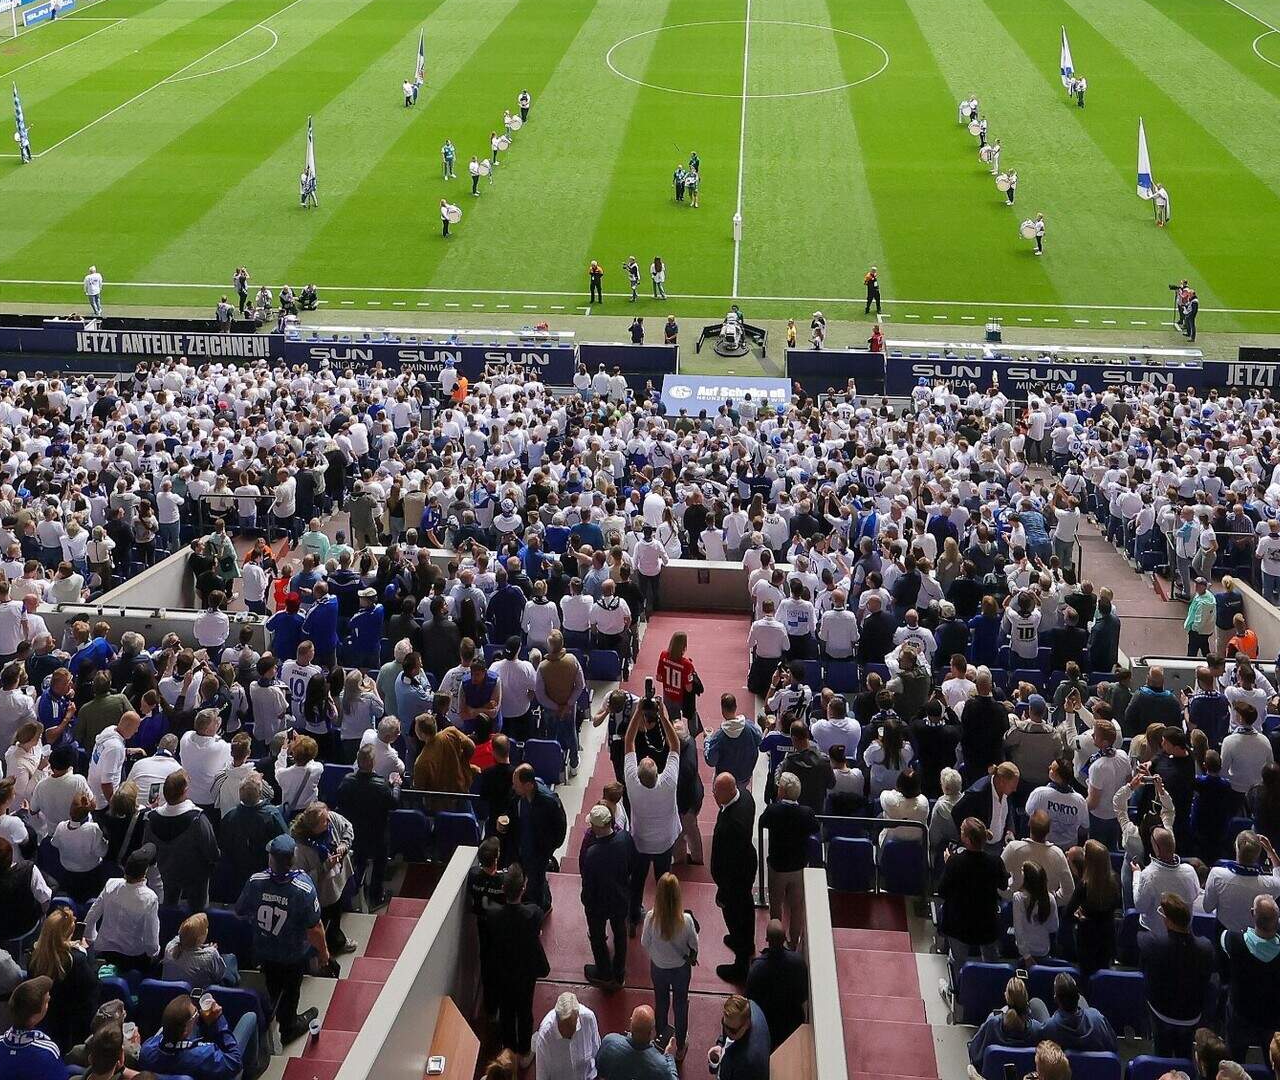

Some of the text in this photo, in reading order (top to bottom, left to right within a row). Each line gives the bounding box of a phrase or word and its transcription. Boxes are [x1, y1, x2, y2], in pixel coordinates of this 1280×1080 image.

[26, 7, 49, 21] SUN
[77, 331, 270, 357] JETZT ANTEILE ZEICHNEN!
[309, 347, 373, 361] SUN
[398, 349, 462, 363] SUN
[484, 352, 551, 365] SUN
[912, 364, 981, 378] SUN
[1007, 367, 1077, 381] SUN
[1102, 370, 1174, 384] SUN
[1226, 364, 1277, 386] JETZT
[697, 386, 719, 396] Auf
[720, 386, 768, 398] Schalke
[664, 665, 681, 689] 10
[289, 677, 305, 698] 10
[1048, 800, 1078, 816] PORTO
[258, 905, 288, 934] 97
